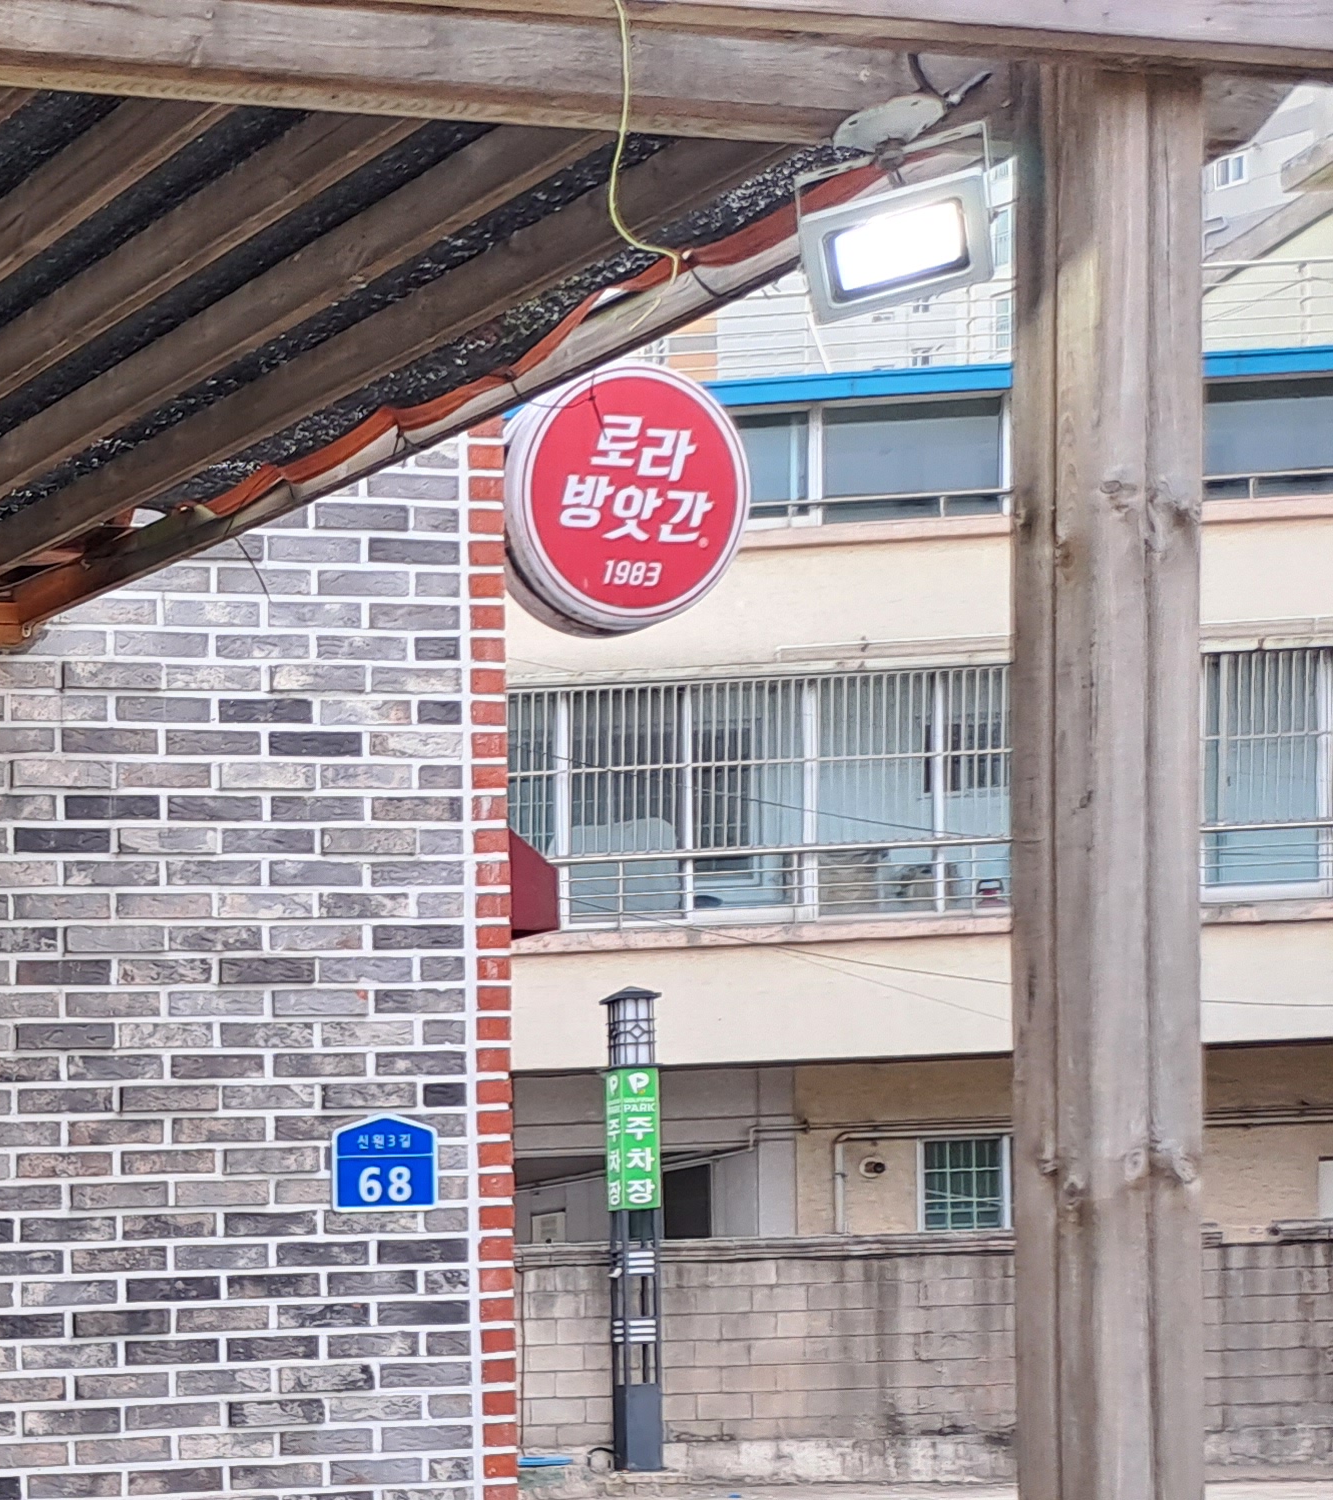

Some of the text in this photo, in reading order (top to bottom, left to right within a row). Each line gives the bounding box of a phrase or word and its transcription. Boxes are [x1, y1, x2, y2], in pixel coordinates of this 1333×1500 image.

[589, 414, 698, 482] 로라
[559, 474, 715, 543] 방앗간
[602, 559, 662, 587] 1983
[623, 1103, 656, 1113] PARK
[358, 1165, 412, 1203] 68
[625, 1116, 656, 1204] 주차장
